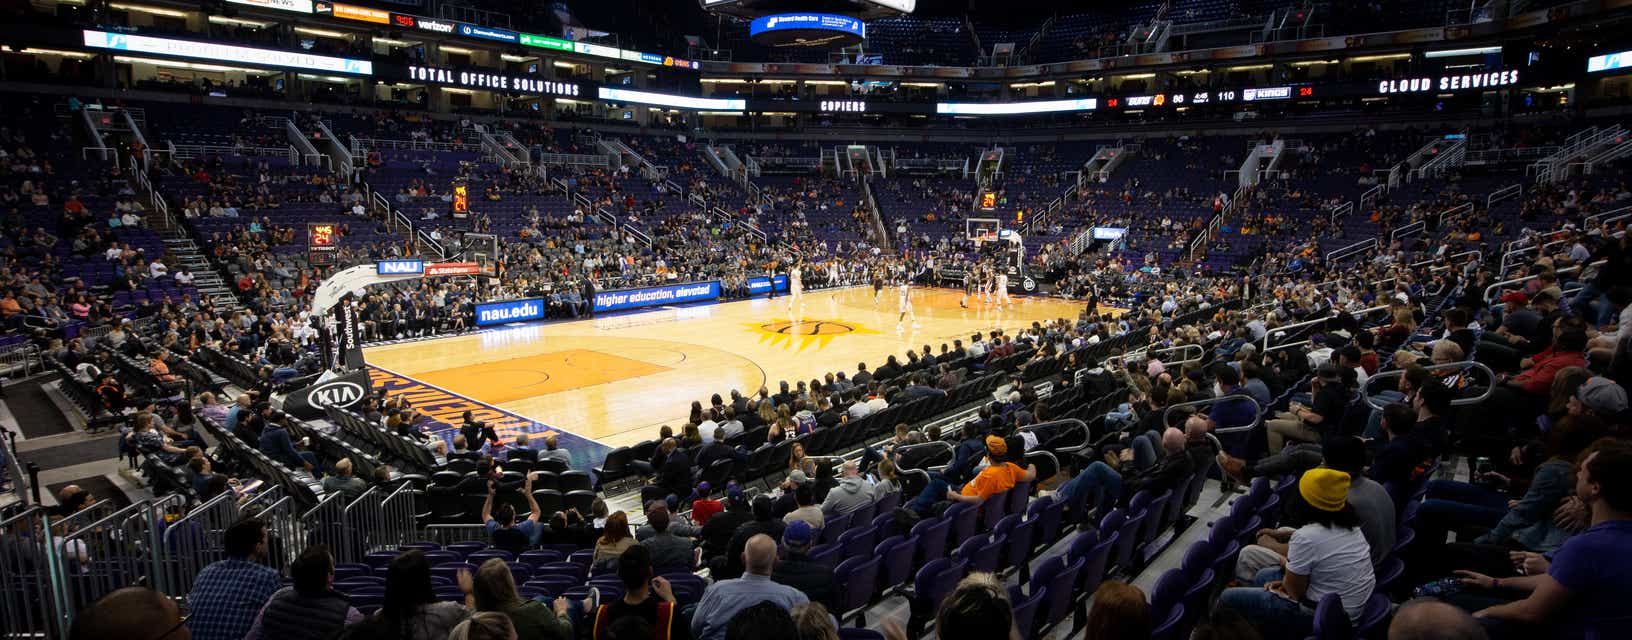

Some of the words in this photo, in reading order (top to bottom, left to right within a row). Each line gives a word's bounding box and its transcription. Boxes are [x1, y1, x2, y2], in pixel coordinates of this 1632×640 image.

[418, 20, 455, 32] verizon
[409, 66, 454, 83] TOTAL
[461, 72, 507, 88] OFFICE
[513, 78, 579, 96] SOLUTIONS
[1380, 78, 1431, 93] CLOUD
[1440, 70, 1518, 90] SERVICES
[1218, 91, 1235, 100] 110
[821, 101, 866, 112] COPIERS
[315, 233, 329, 244] 24
[384, 262, 418, 273] NAU
[596, 294, 628, 307] higher
[629, 290, 674, 303] education,
[676, 284, 710, 297] elevated
[481, 302, 538, 321] nau.edu
[344, 305, 355, 350] Southwest
[317, 386, 357, 405] KIA
